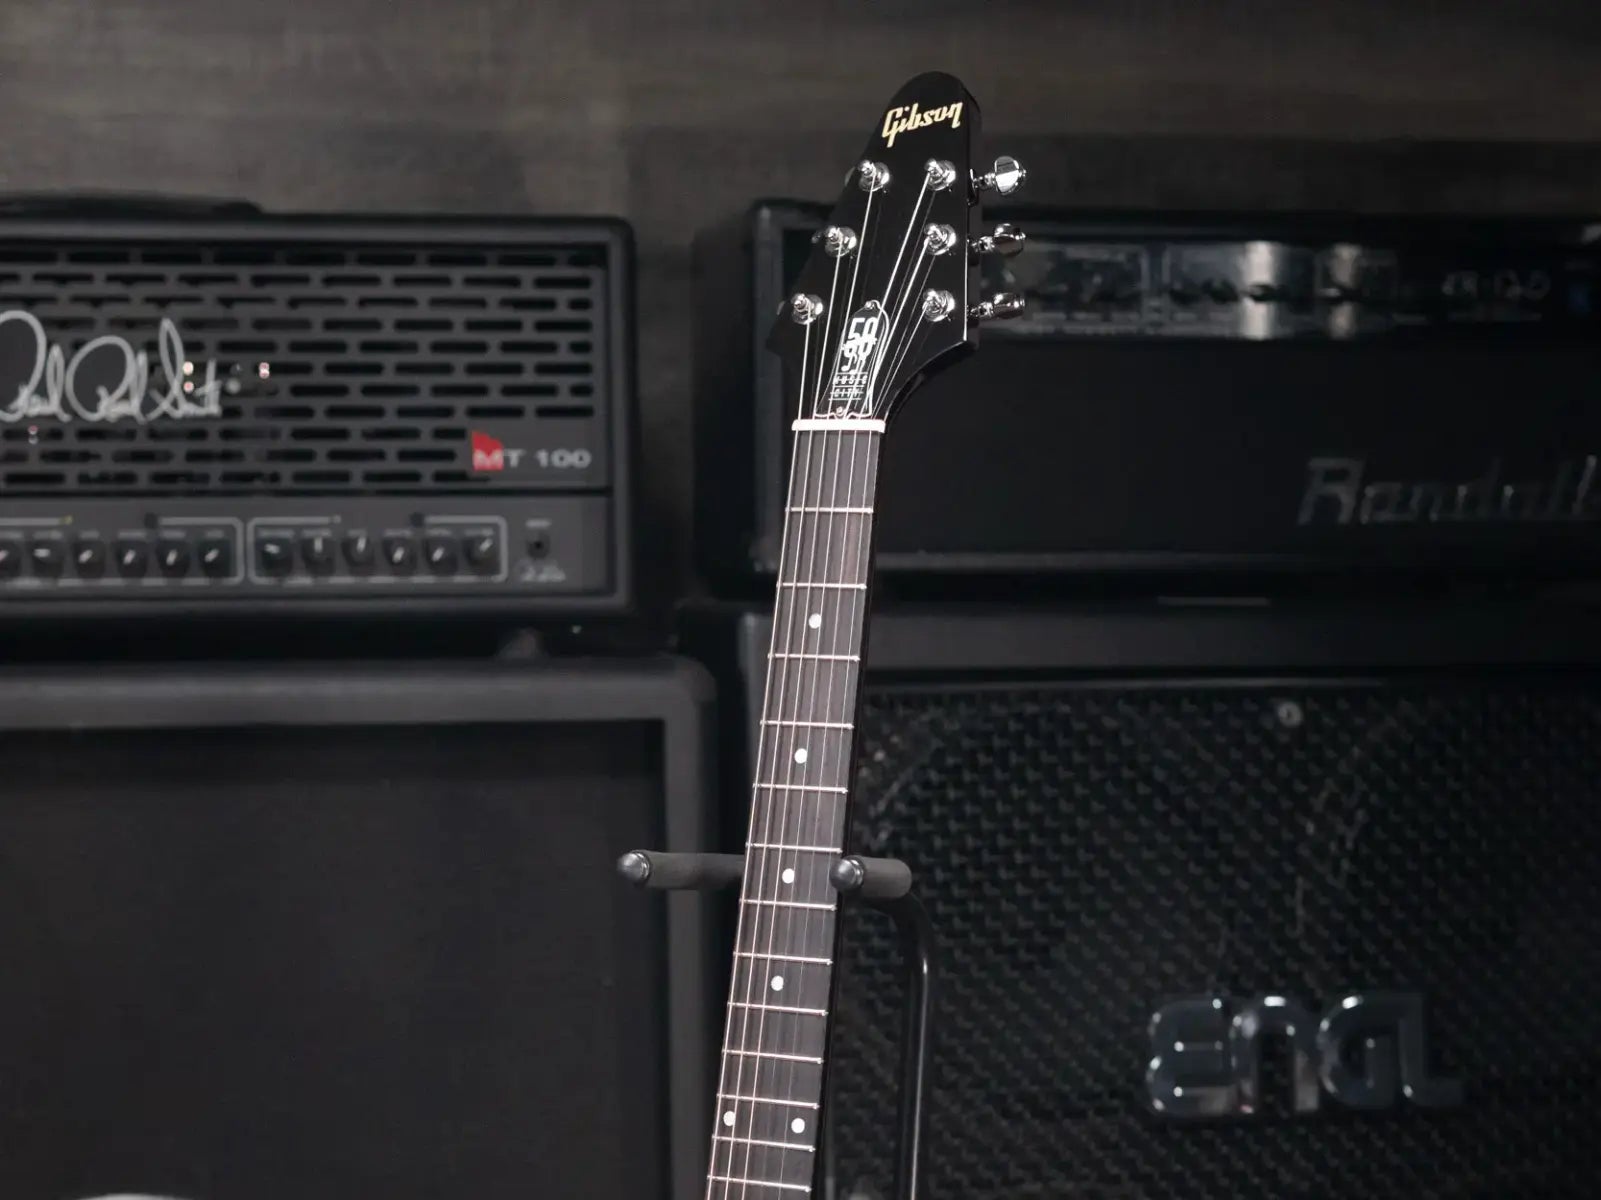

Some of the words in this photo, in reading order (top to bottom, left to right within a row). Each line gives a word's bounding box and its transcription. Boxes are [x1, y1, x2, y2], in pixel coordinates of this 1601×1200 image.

[882, 101, 963, 147] Gibson
[473, 448, 525, 469] MT
[535, 448, 592, 469] 100
[1296, 455, 1599, 525] Randall
